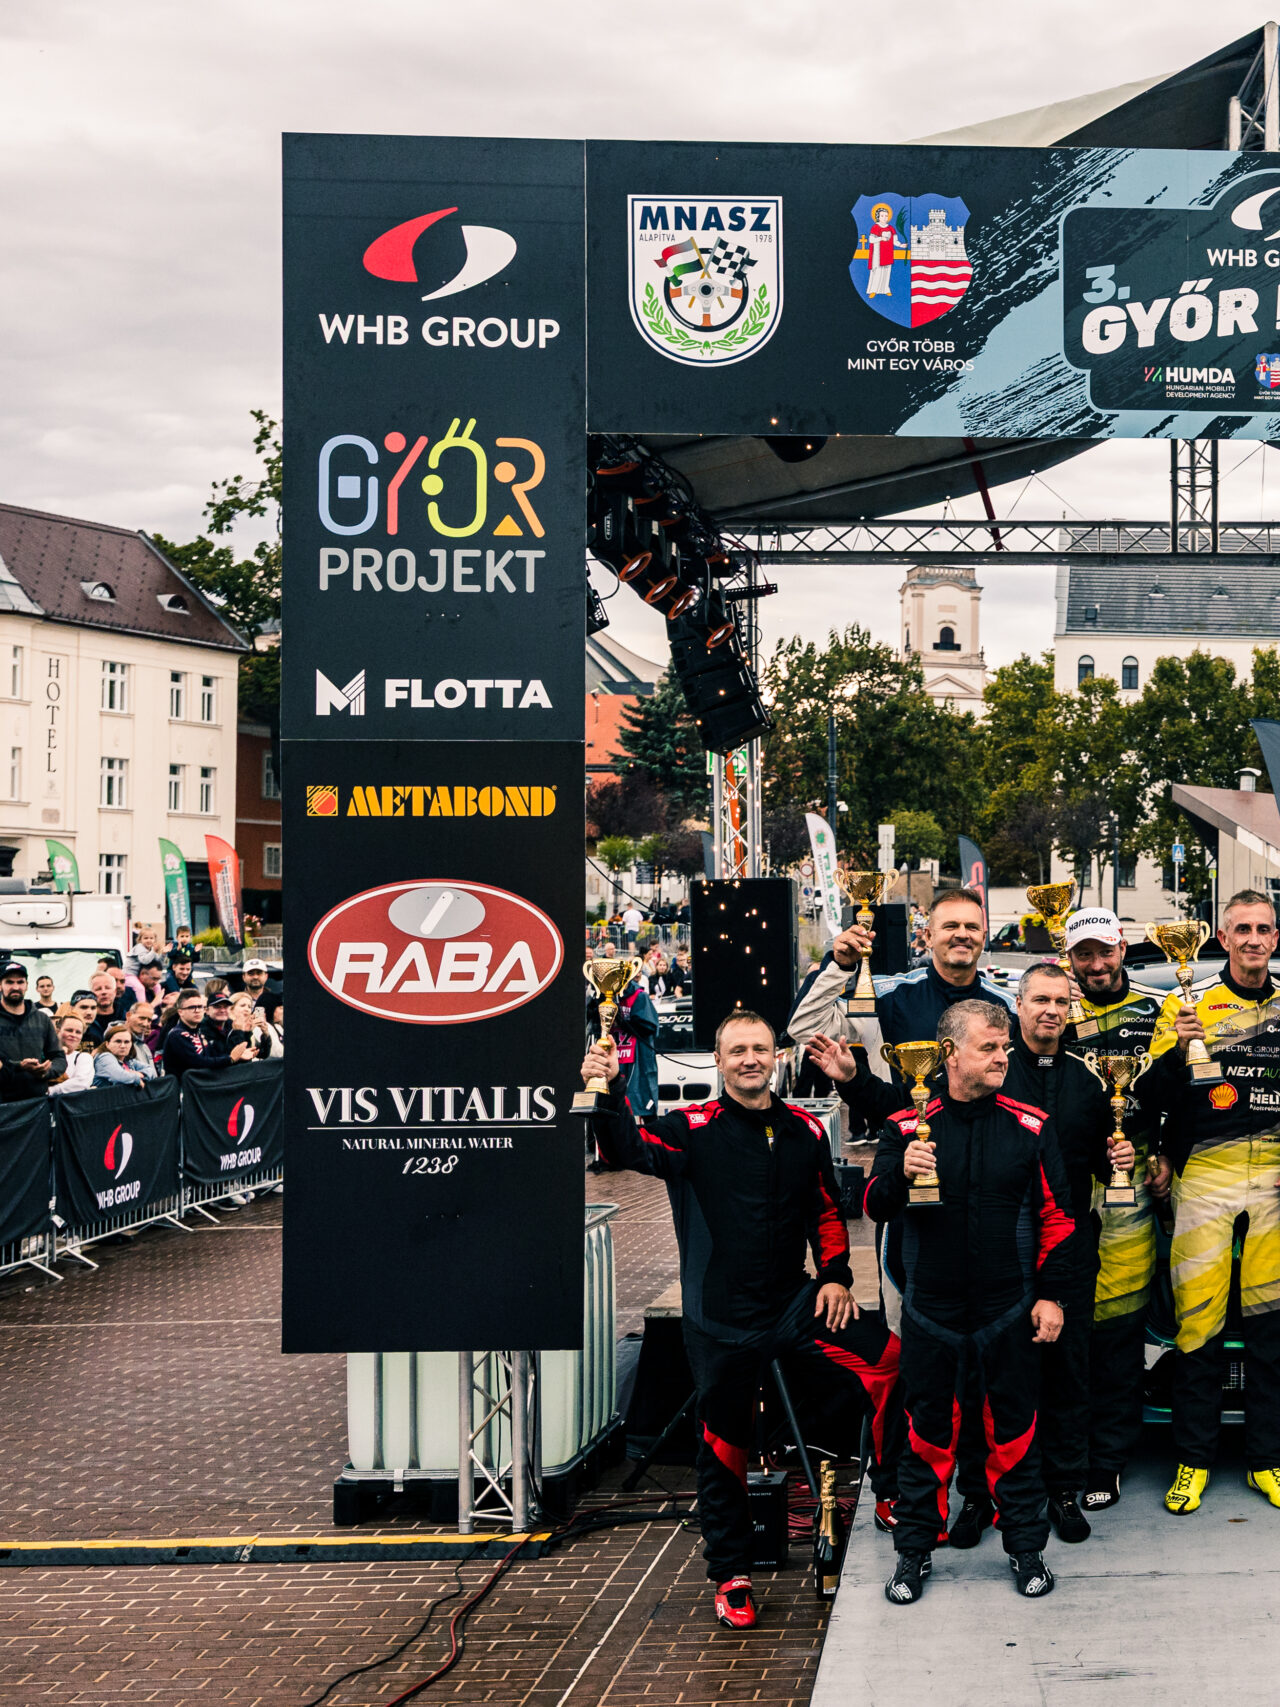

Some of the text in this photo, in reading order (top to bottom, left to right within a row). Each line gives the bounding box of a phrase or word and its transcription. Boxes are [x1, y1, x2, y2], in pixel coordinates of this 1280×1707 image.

[638, 205, 771, 232] MNASZ
[639, 232, 676, 242] ALAPÍTVA
[754, 234, 773, 243] 1978
[1206, 248, 1258, 268] WHB
[1082, 264, 1131, 304] 3.
[1082, 277, 1260, 355] GYŐR
[319, 313, 560, 349] WHB GROUP
[866, 337, 955, 353] GYŐR TÖBB
[847, 355, 975, 371] MINT EGY VÁROS
[1165, 366, 1236, 384] HUMDA
[1166, 391, 1210, 399] DEVELOPMENT
[318, 417, 546, 538] GYŐR
[319, 547, 546, 593] PROJEKT
[385, 678, 553, 709] FLOTTA
[46, 657, 60, 773] HOTEL
[1212, 1045, 1252, 1053] EFFECTIVE
[307, 1085, 557, 1124] VIS VITALIS
[342, 1137, 513, 1150] NATURAL MINERAL WATER
[220, 1146, 262, 1171] WHB GROUP
[402, 1155, 459, 1175] 1238
[96, 1180, 141, 1210] WHB GROUP
[1087, 1492, 1111, 1504] OMP
